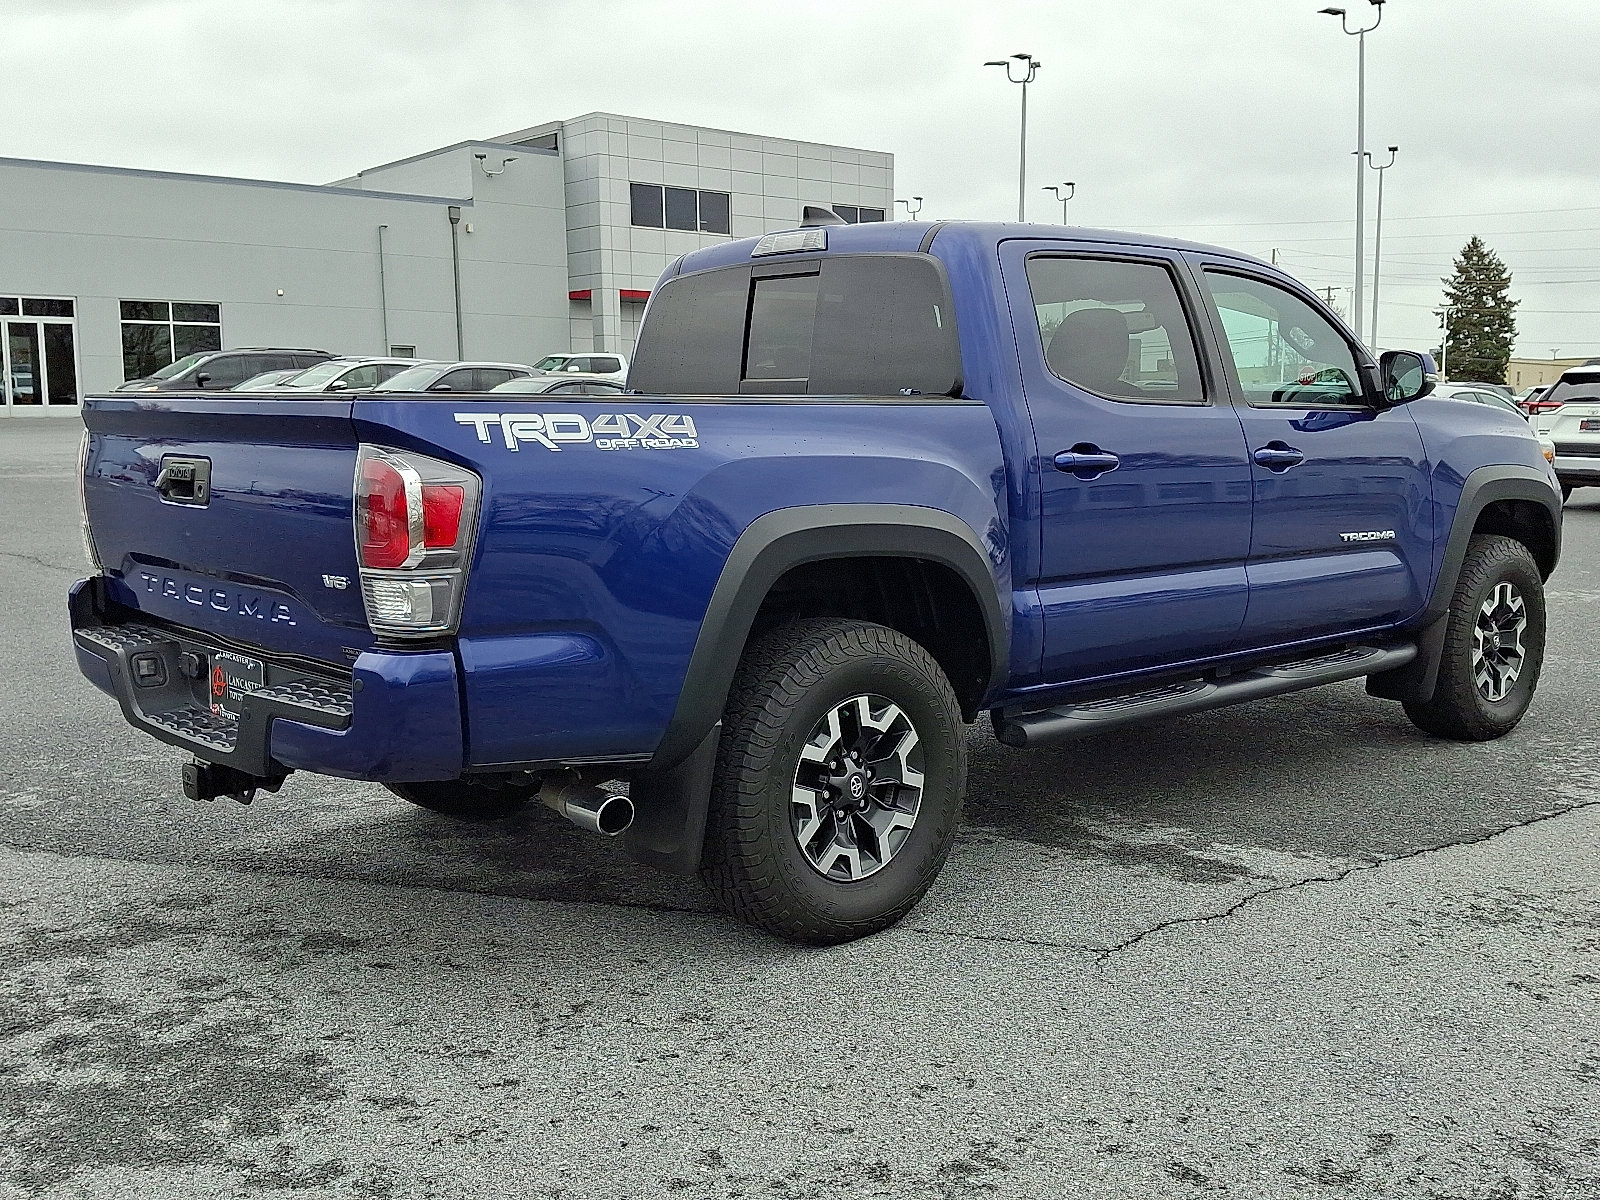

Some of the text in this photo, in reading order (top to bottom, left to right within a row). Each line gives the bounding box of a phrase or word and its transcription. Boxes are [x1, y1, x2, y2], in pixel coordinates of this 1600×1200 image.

[454, 412, 698, 451] TRD 4X4
[595, 438, 700, 450] OFF ROAD
[168, 466, 191, 479] TOYOTA
[1339, 530, 1396, 542] TACOMA
[321, 574, 351, 590] V6
[140, 571, 297, 626] TACOMA
[219, 651, 249, 664] LANCASTER
